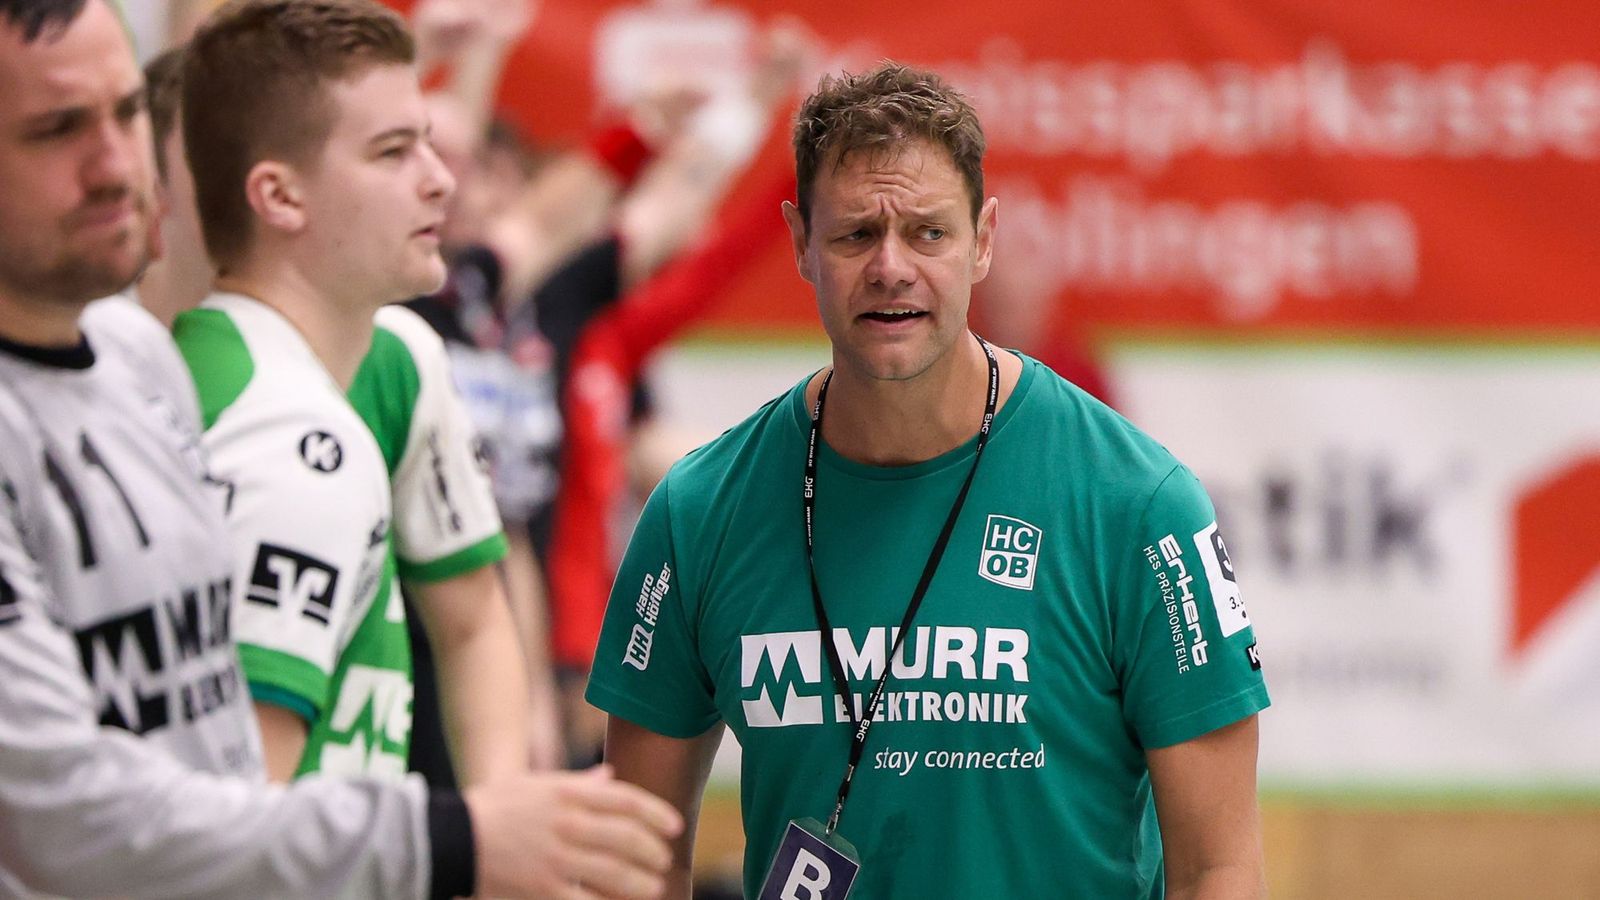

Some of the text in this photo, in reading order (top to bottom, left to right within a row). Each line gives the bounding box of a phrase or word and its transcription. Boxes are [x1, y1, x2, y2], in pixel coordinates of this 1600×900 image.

[981, 413, 993, 435] EHG
[804, 475, 814, 498] EHG
[991, 524, 1034, 552] HC
[986, 554, 1030, 579] OB
[635, 572, 655, 618] Harro
[643, 562, 671, 627] Höfliger
[1143, 545, 1190, 675] HES PRÄZISIONSTEILE
[832, 625, 1030, 683] MURR
[834, 691, 1030, 724] ELEKTRONIK
[856, 718, 871, 743] EHG
[874, 743, 1046, 776] stay connected
[779, 847, 832, 900] B
